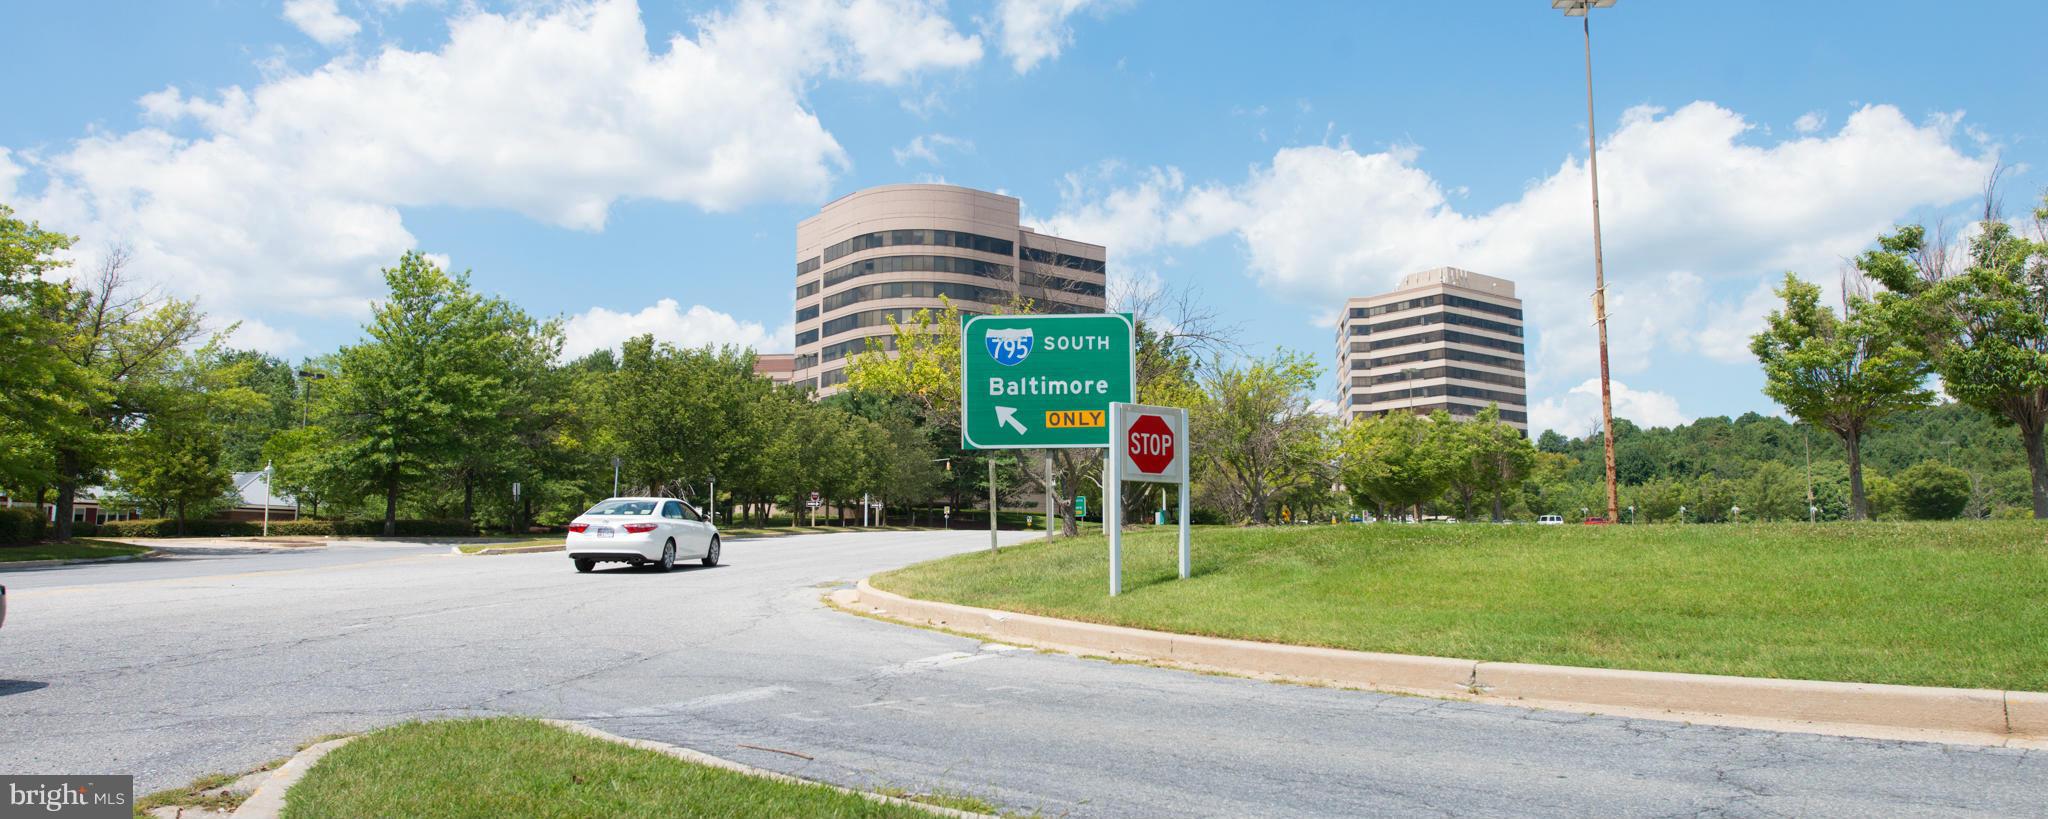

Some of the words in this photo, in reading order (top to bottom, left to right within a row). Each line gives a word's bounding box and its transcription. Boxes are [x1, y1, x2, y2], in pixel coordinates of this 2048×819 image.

[991, 338, 1029, 359] 795
[1044, 335, 1110, 350] SOUTH
[989, 376, 1109, 396] Baltimore
[1049, 411, 1102, 427] ONLY
[1130, 432, 1172, 456] STOP
